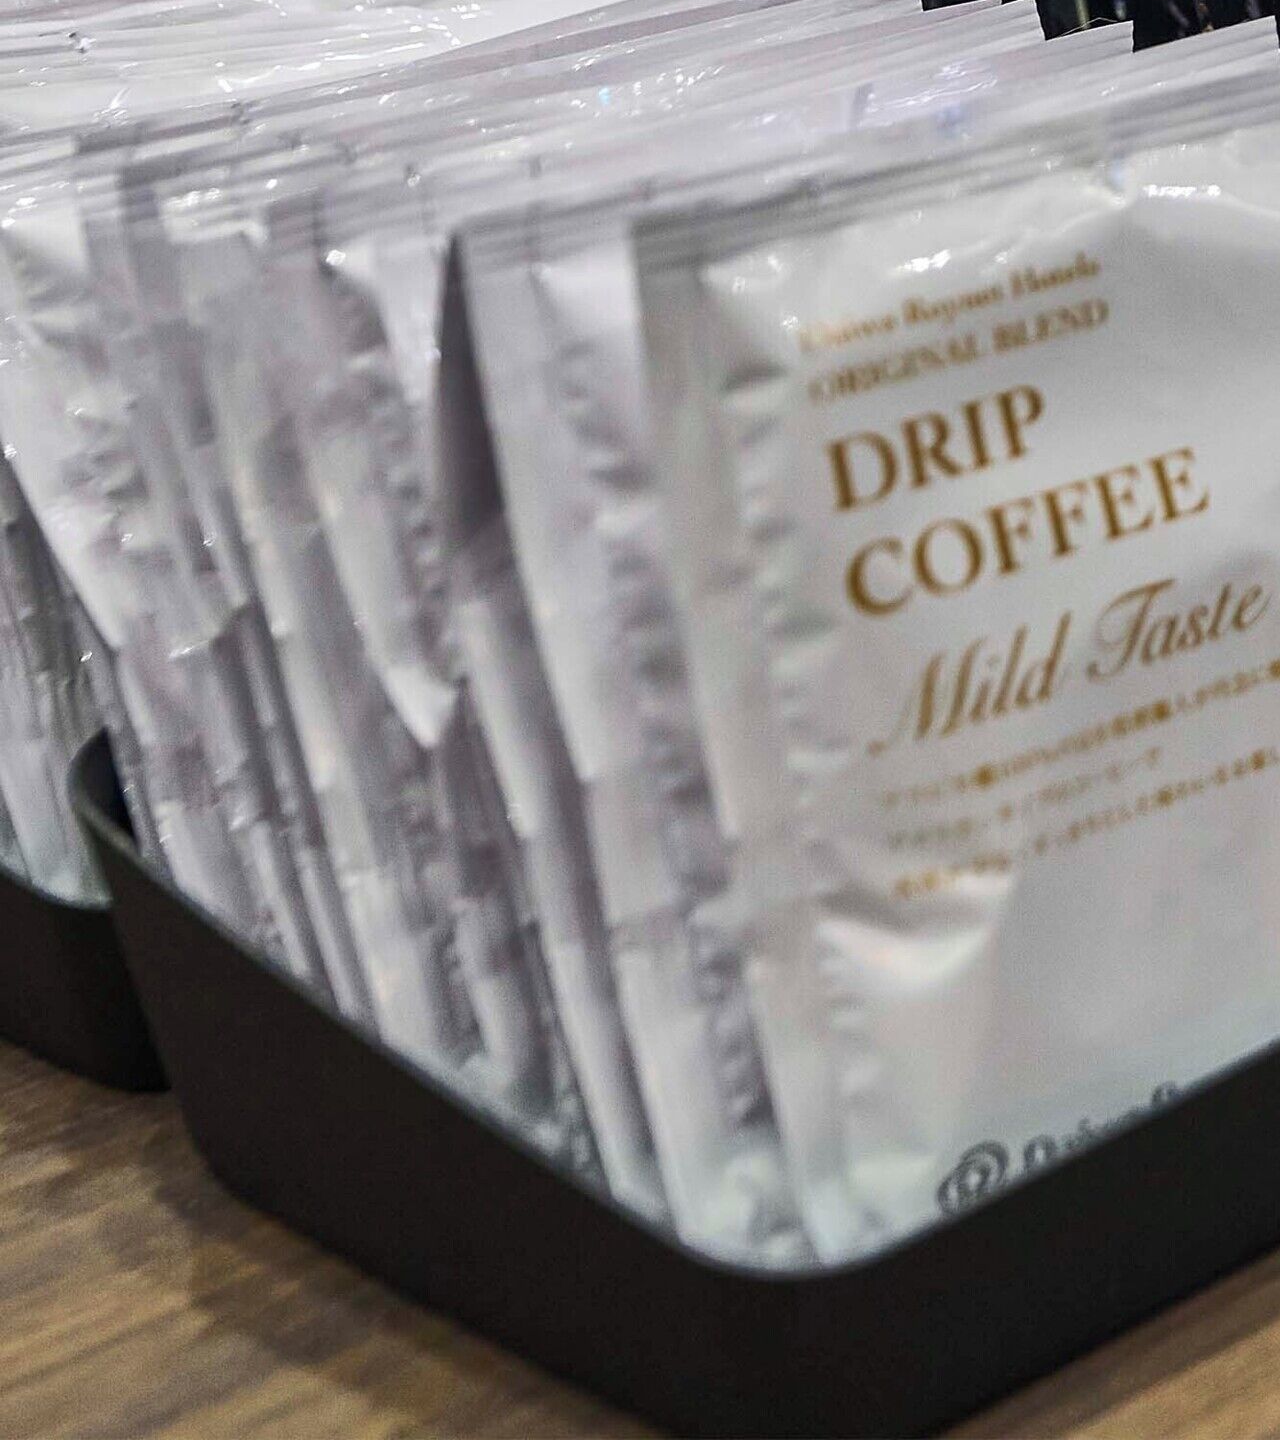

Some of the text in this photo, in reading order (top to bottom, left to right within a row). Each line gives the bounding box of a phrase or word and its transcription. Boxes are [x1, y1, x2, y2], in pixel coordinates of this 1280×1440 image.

[824, 383, 1046, 512] DRIP
[844, 446, 1211, 619] COFFEE
[866, 608, 1073, 757] Mild
[1086, 578, 1275, 681] Taste
